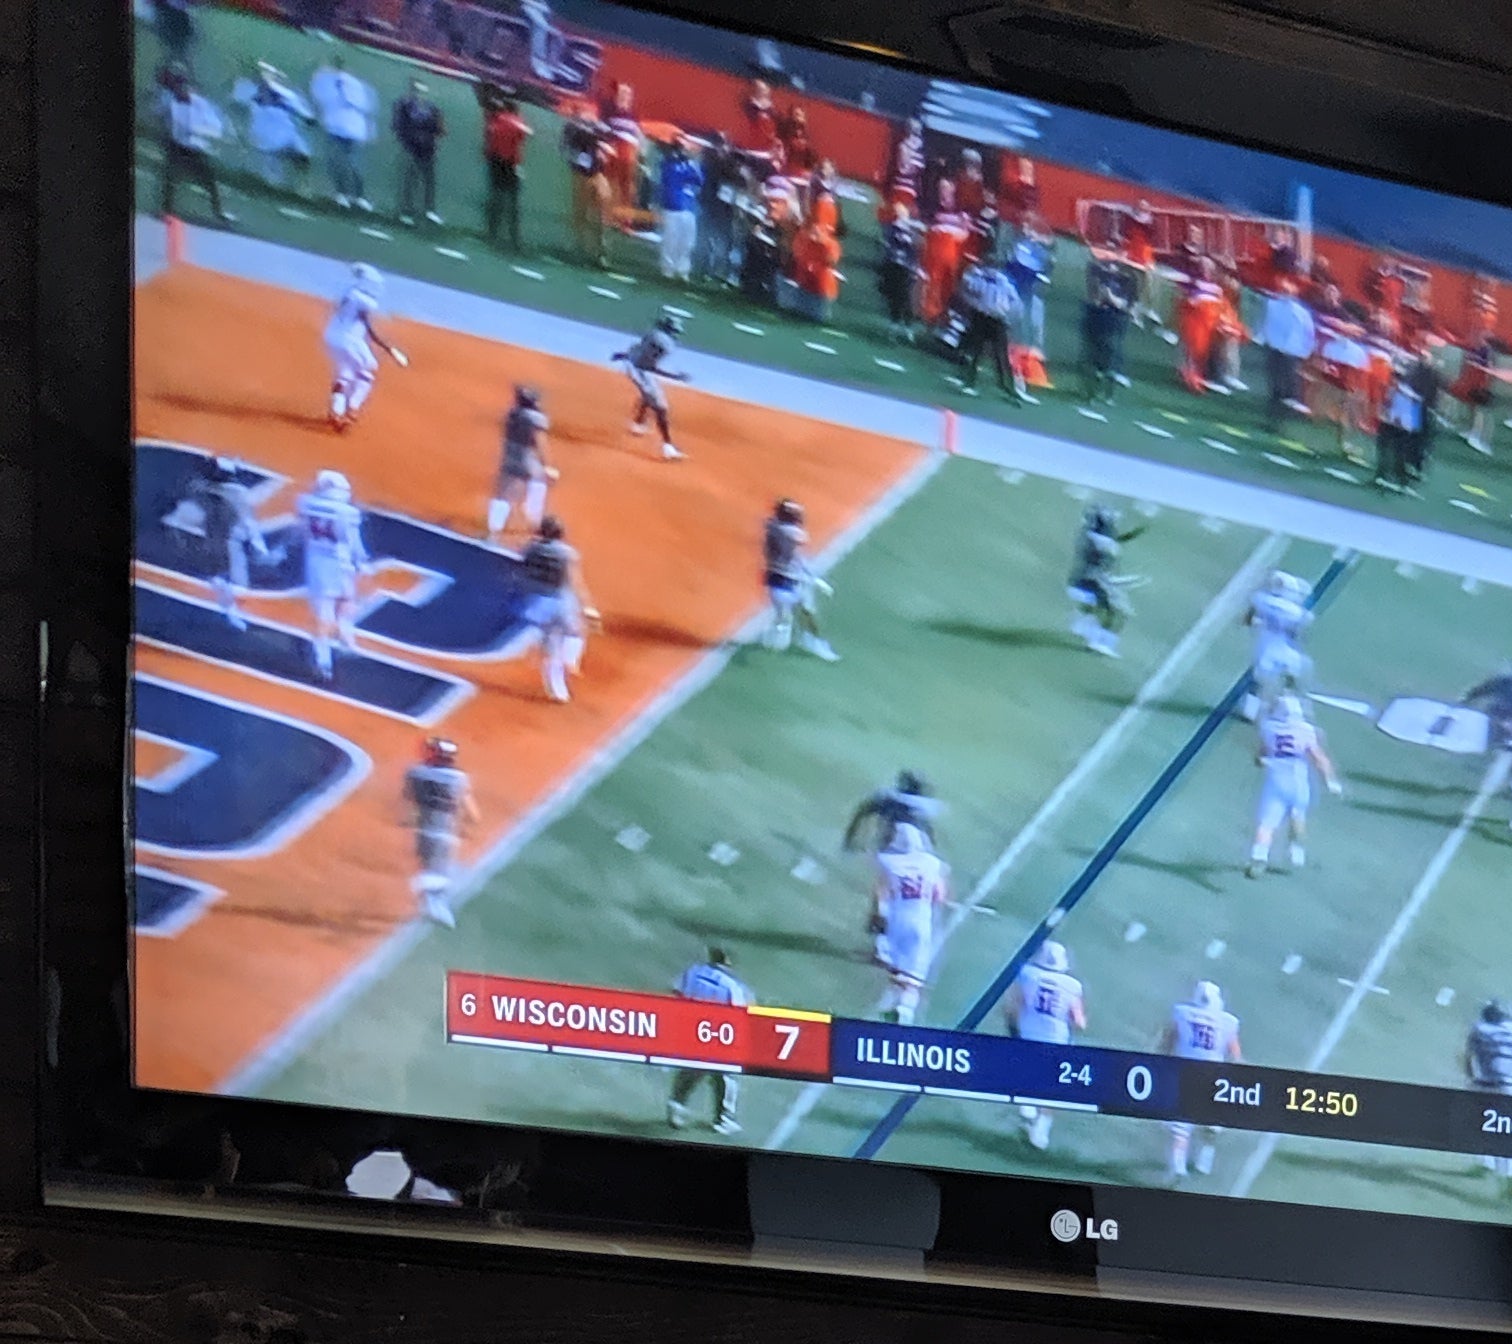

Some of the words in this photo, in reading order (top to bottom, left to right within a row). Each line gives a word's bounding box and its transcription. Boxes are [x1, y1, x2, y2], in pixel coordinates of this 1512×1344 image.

[461, 993, 477, 1017] 6
[491, 995, 657, 1038] WISCONSIN
[697, 1020, 735, 1046] 6-0
[774, 1024, 800, 1061] 7
[856, 1037, 971, 1074] ILLINOIS
[1058, 1061, 1092, 1087] 2-4
[1126, 1065, 1153, 1101] 0
[1213, 1078, 1262, 1107] 2nd
[1285, 1086, 1359, 1118] 12:50
[1086, 1218, 1118, 1240] LG
